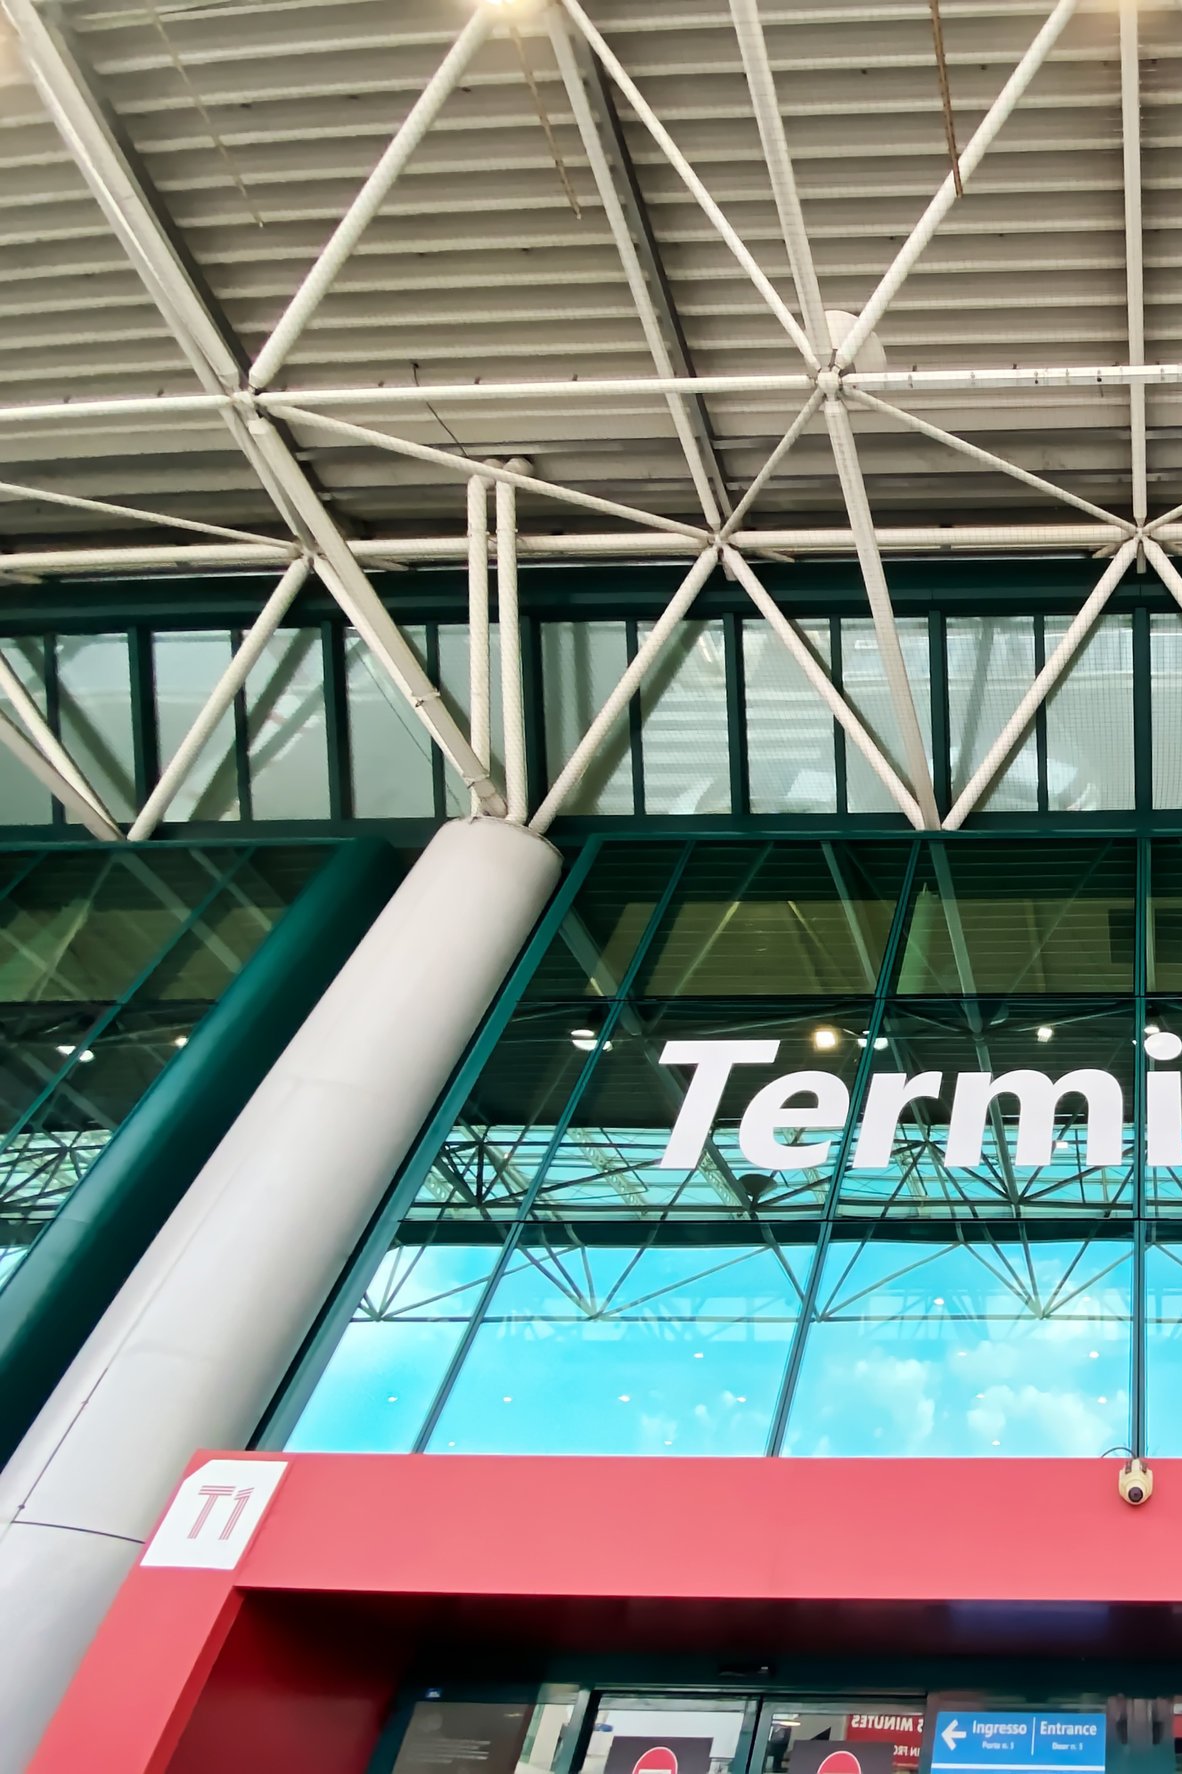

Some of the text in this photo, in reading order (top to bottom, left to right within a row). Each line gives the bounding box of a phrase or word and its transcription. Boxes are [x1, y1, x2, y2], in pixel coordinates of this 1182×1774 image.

[187, 1485, 254, 1540] T1
[972, 1720, 1027, 1737] Ingresso
[1040, 1720, 1097, 1736] Entrance
